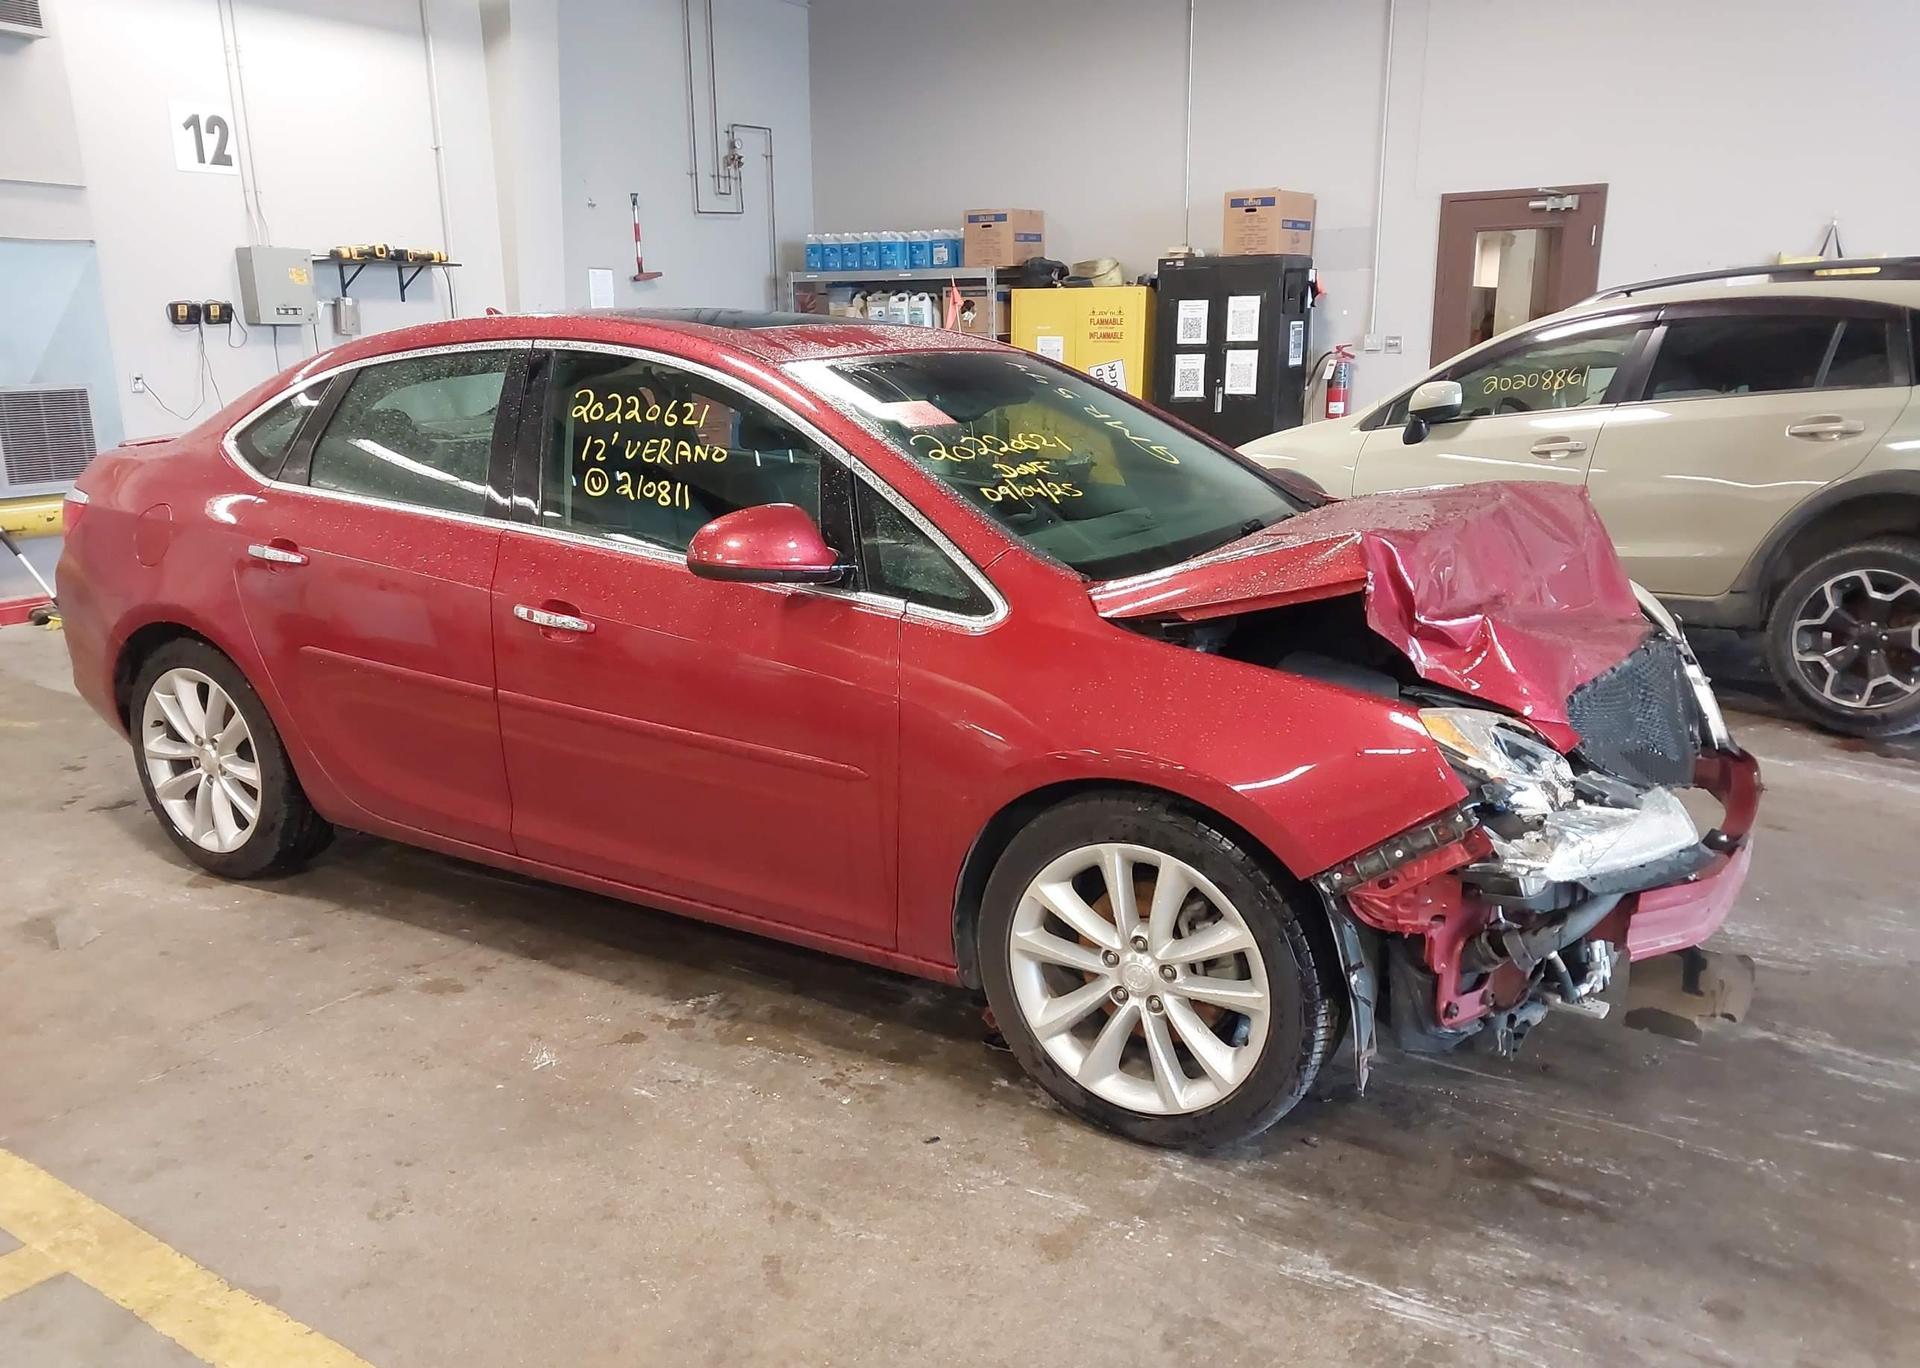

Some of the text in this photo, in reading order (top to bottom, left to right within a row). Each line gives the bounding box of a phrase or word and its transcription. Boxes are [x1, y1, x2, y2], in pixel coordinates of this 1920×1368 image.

[182, 114, 233, 167] 12
[1088, 331, 1124, 340] INFLAMMABLE
[1089, 317, 1124, 326] FLAMMABLE
[1107, 363, 1119, 388] UCK
[1482, 365, 1591, 397] 20208861
[572, 389, 711, 428] 20220621
[625, 438, 728, 465] VERANO
[909, 434, 1072, 463] 20220621
[992, 461, 1059, 479] DONE
[615, 471, 690, 510] 210811
[979, 478, 1084, 506] 09/04/25
